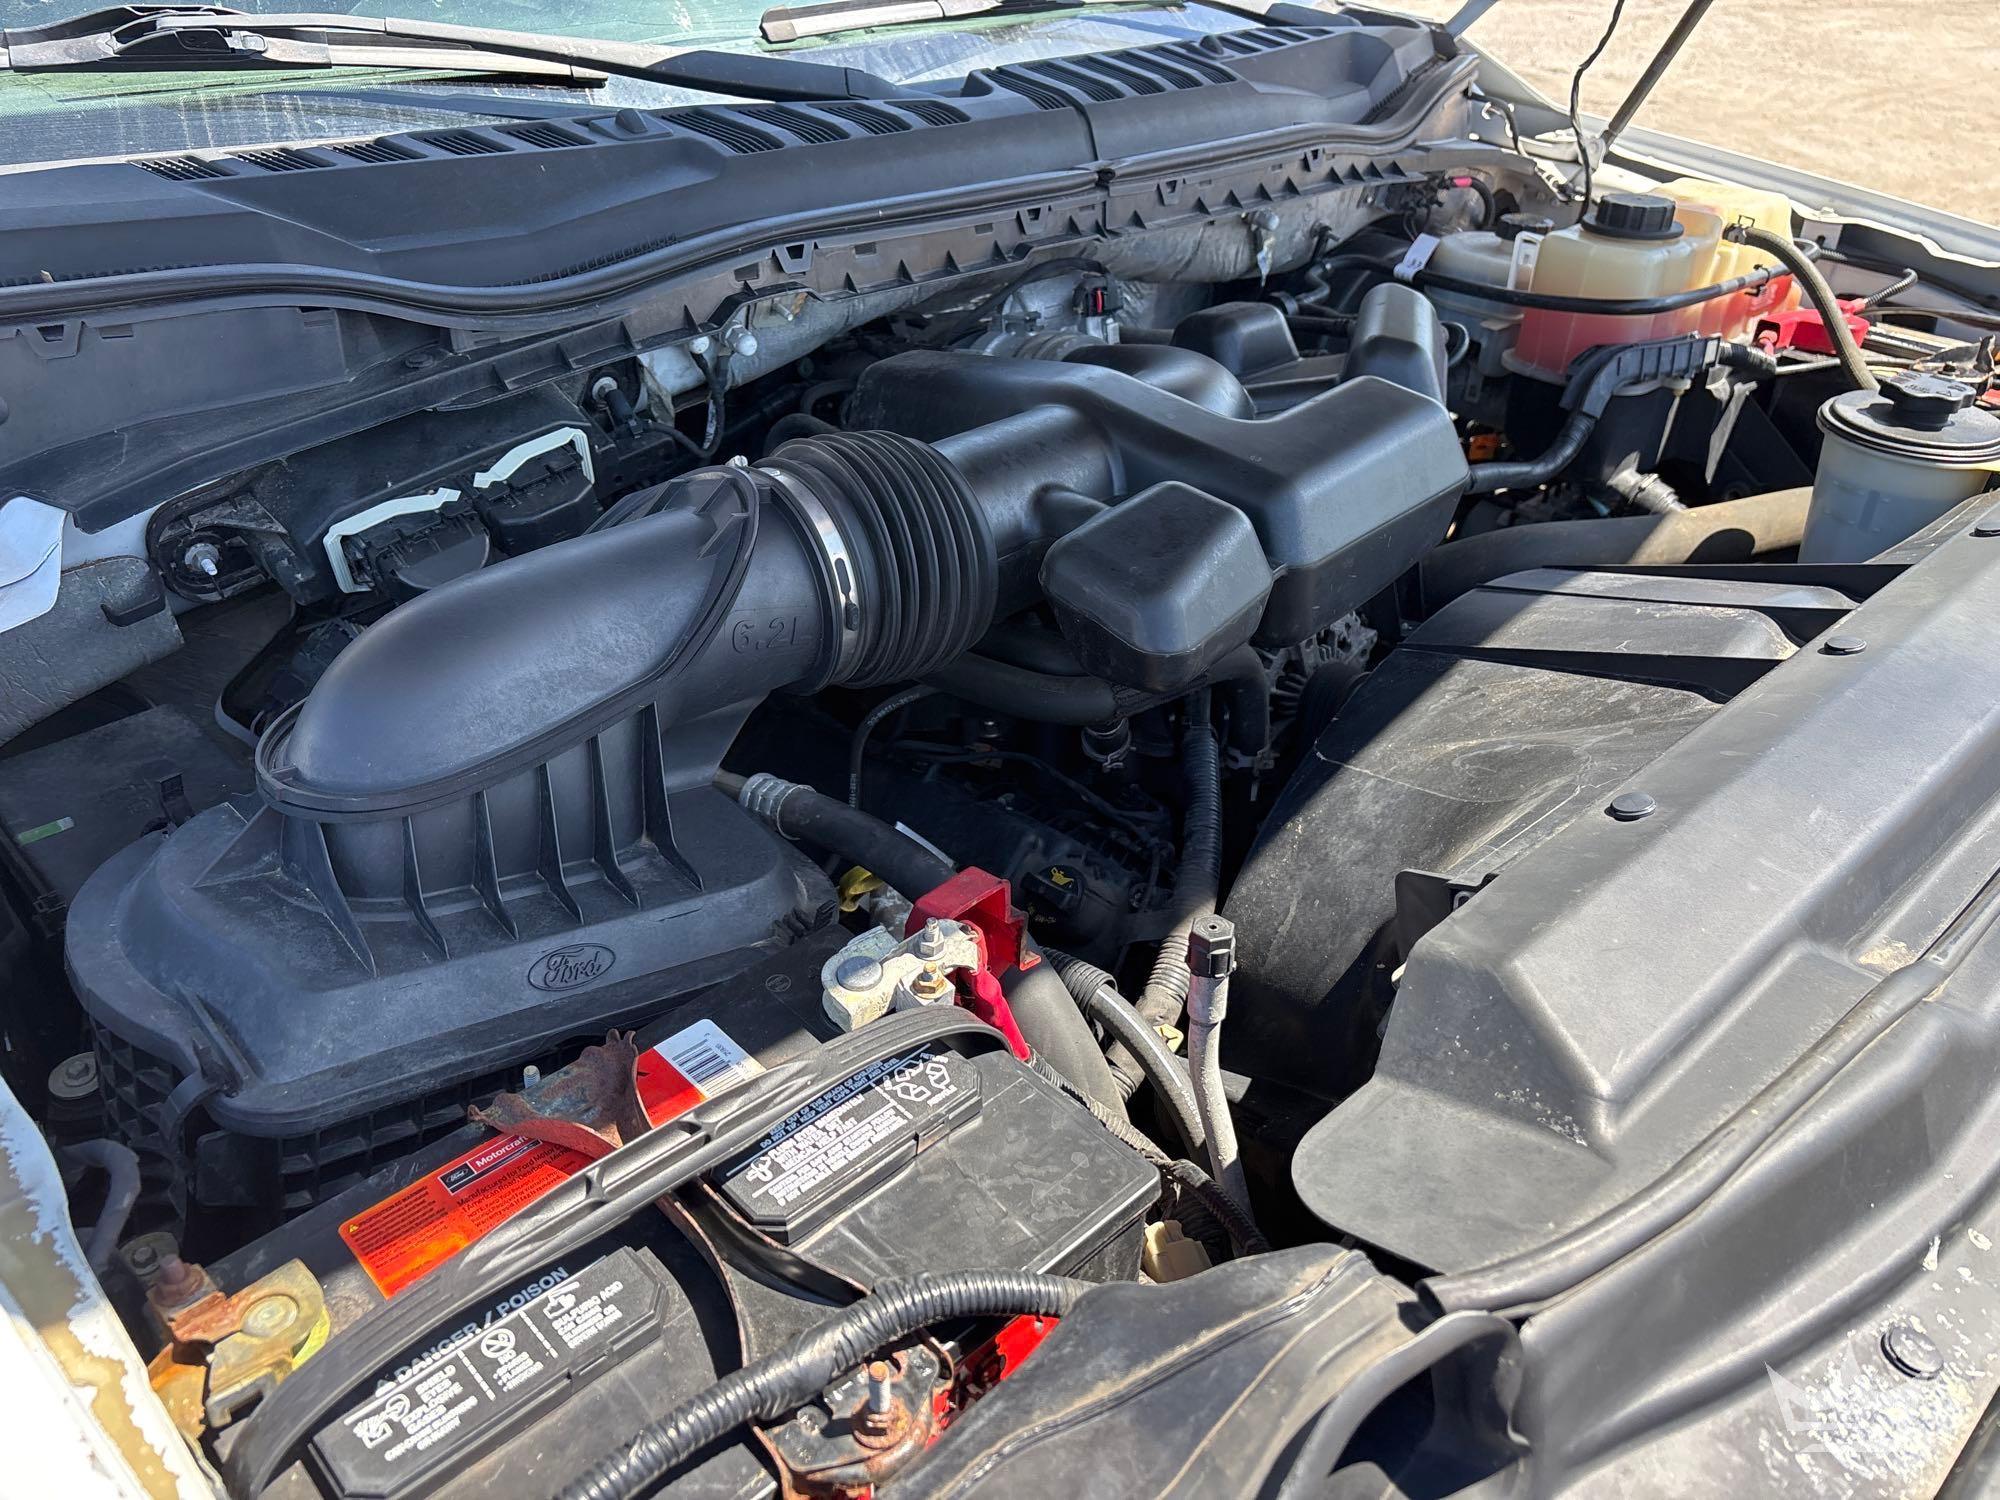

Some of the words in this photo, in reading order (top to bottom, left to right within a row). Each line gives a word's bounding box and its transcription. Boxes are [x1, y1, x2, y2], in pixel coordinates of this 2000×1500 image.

[544, 947, 601, 988] Ford
[760, 1138, 771, 1148] DO
[771, 1129, 785, 1140] NOT
[786, 1120, 799, 1131] TIP.
[800, 1109, 816, 1122] KEEP
[816, 1099, 832, 1112] VENT
[833, 1088, 849, 1101] CAPS
[850, 1076, 868, 1089] TIGHT
[868, 1067, 881, 1078] AND
[881, 1057, 898, 1070] LEVEL
[769, 1122, 785, 1135] KEEP
[786, 1113, 799, 1124] OUT
[800, 1106, 810, 1115] OF
[810, 1097, 824, 1108] THE
[824, 1084, 844, 1099] REACH
[844, 1078, 853, 1086] OF
[853, 1059, 883, 1081] CHILDREN
[517, 1159, 533, 1171] Ford
[394, 1321, 481, 1384] DANGER
[495, 1265, 569, 1317] POISON
[551, 1295, 600, 1329] SULFURIC
[599, 1280, 623, 1299] ACID
[498, 1349, 516, 1364] NO
[414, 1364, 456, 1394] SHIELD
[420, 1379, 452, 1402] EYES
[399, 1382, 463, 1426] EXPLOSIVE
[405, 1404, 447, 1434] GASES
